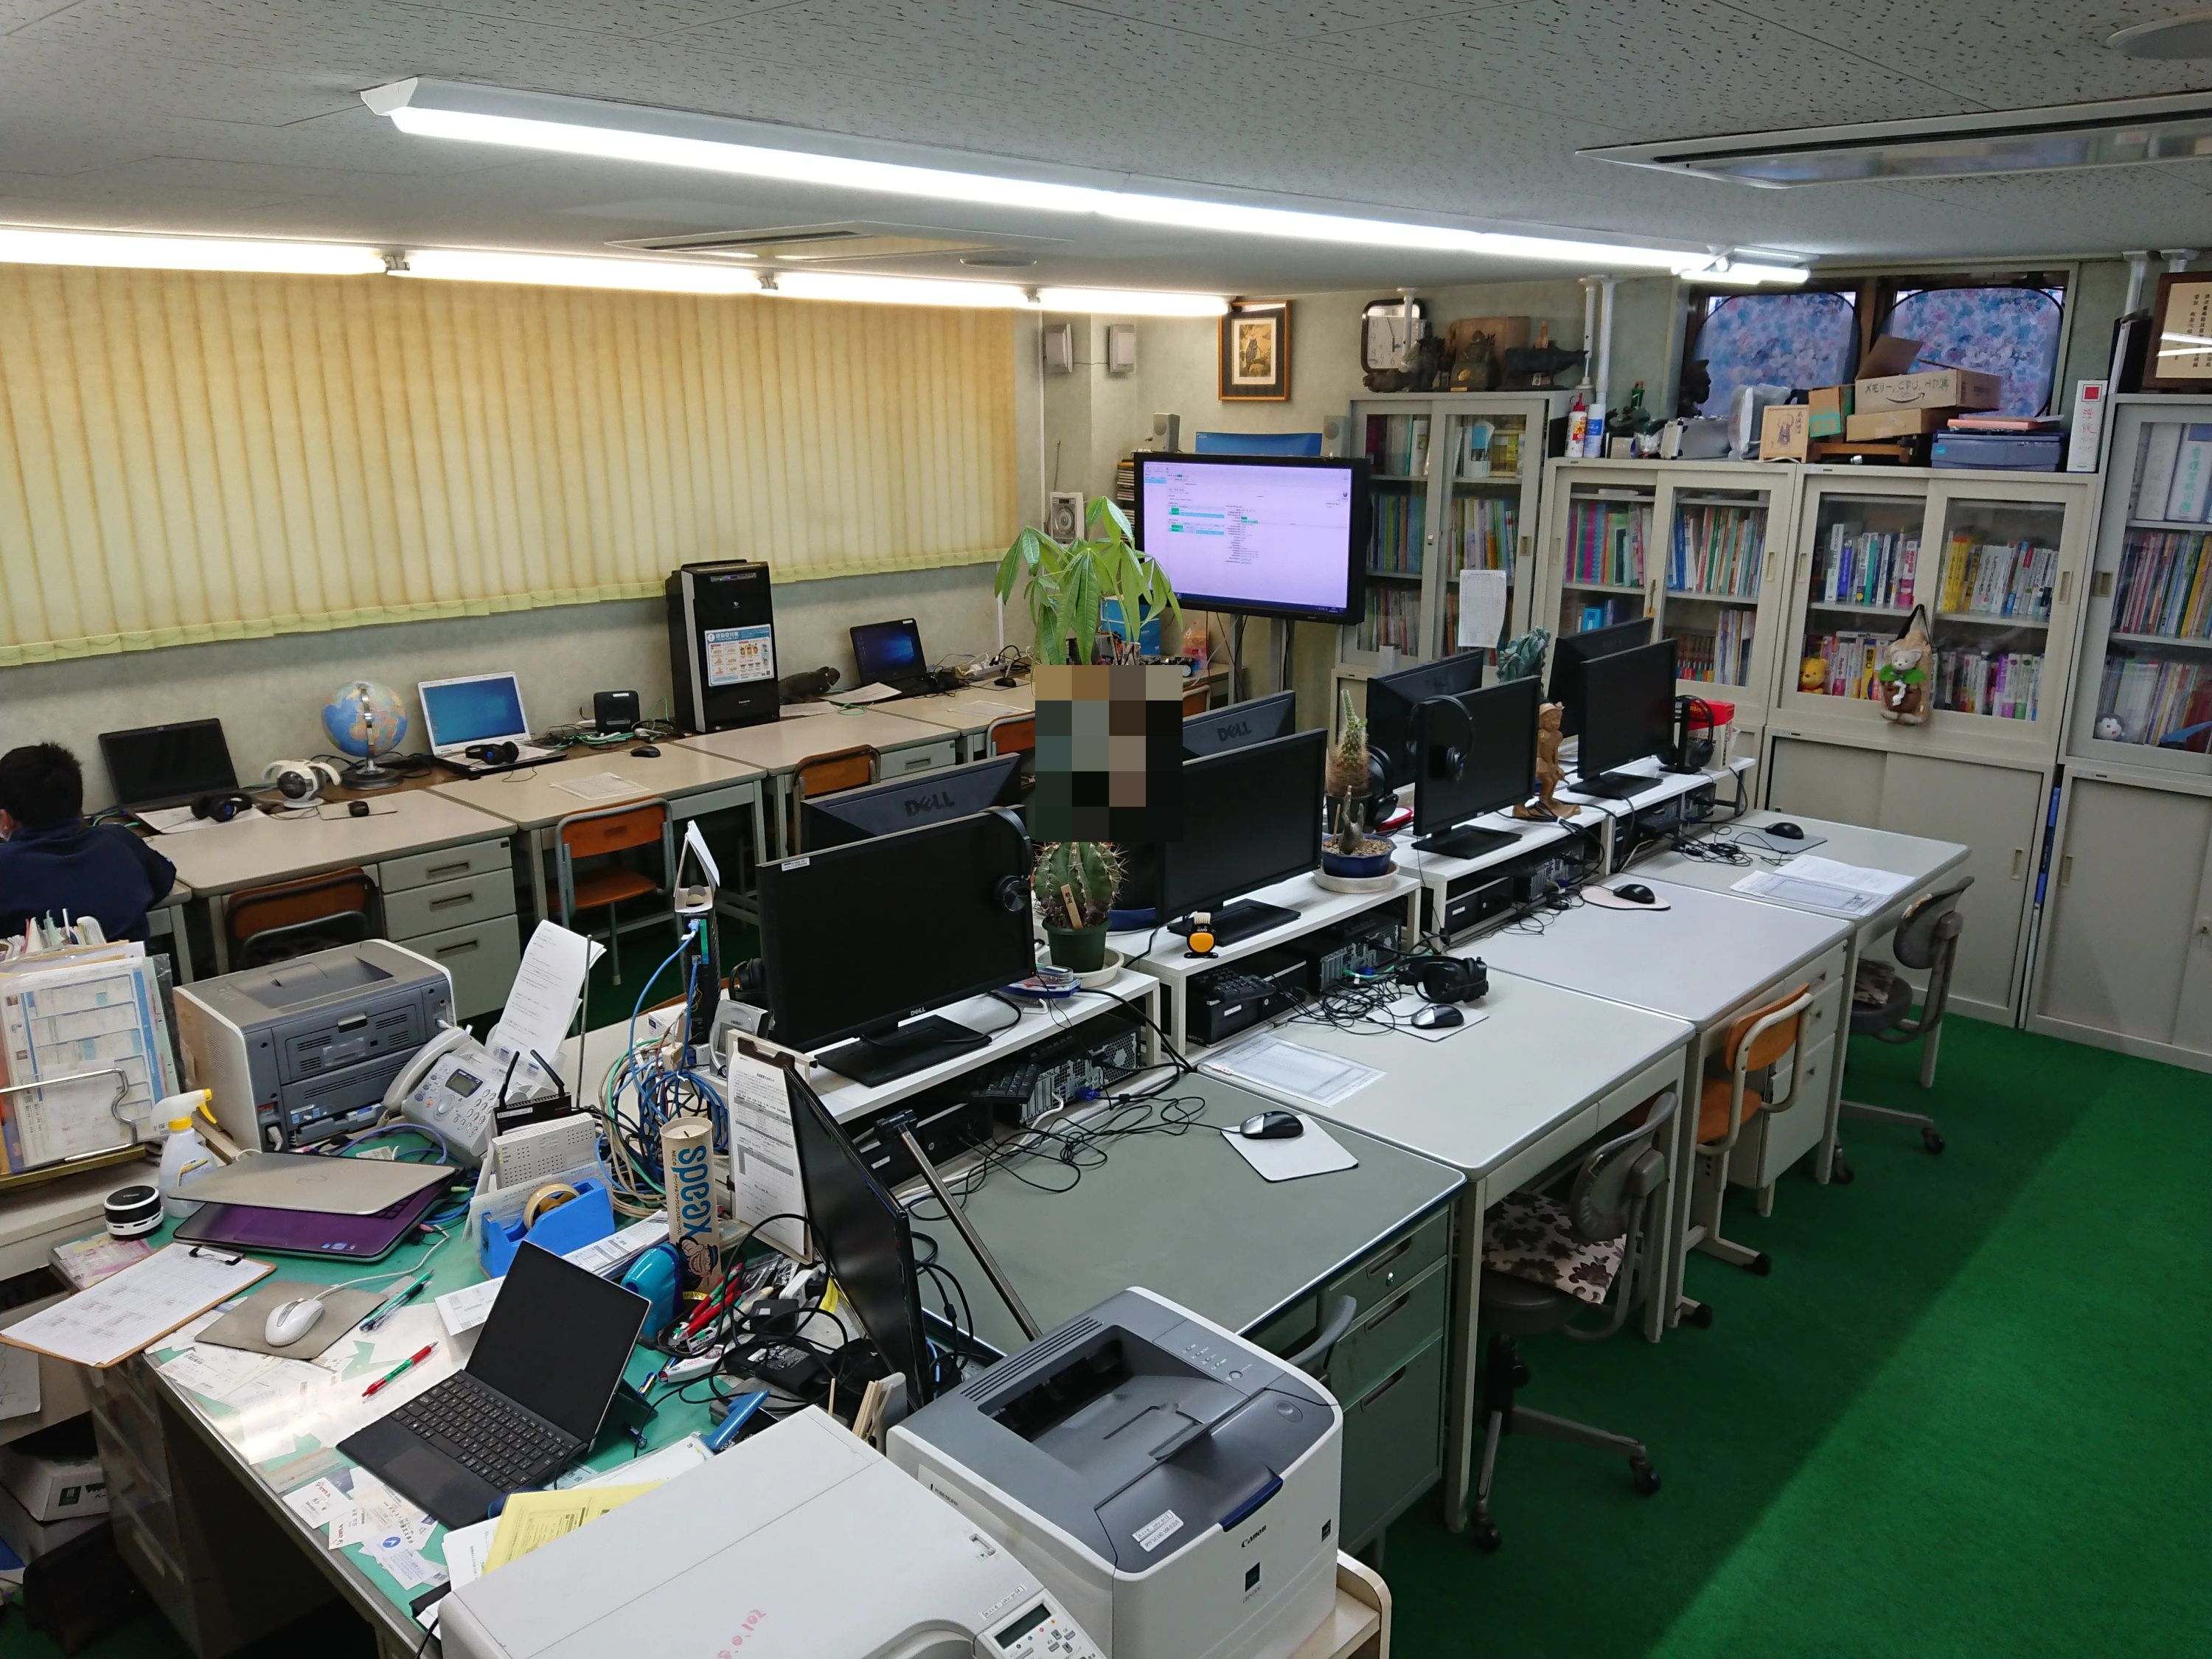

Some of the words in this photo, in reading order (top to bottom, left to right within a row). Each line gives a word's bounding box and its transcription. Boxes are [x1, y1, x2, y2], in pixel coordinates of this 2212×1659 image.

[1216, 721, 1252, 742] DELL
[904, 791, 955, 817] DELL
[910, 1006, 926, 1017] DELL
[670, 1144, 712, 1238] speax
[1241, 1524, 1267, 1548] Canon
